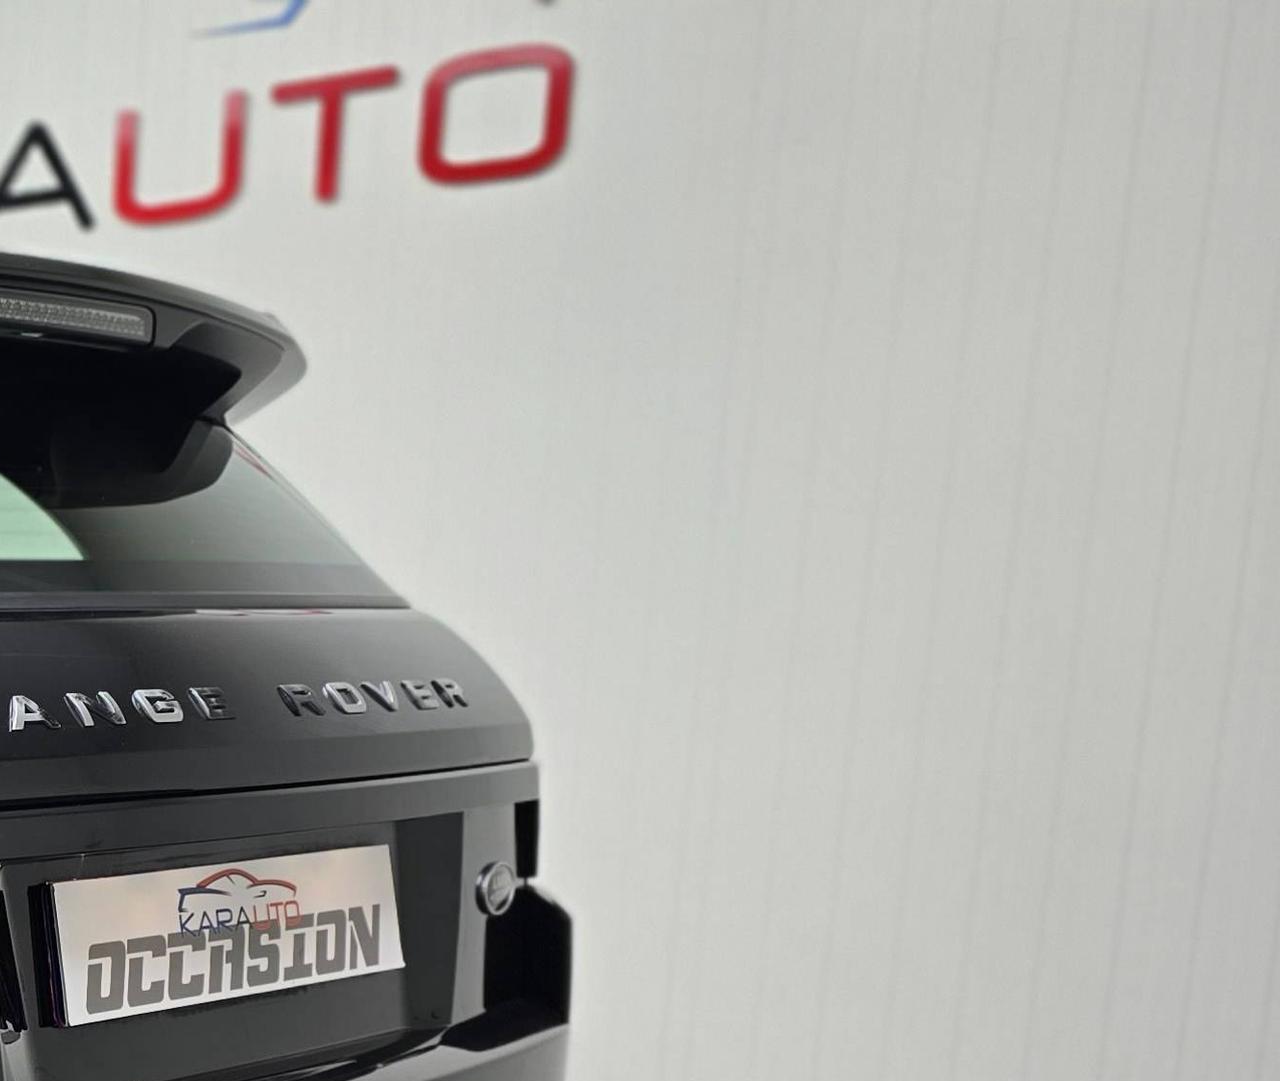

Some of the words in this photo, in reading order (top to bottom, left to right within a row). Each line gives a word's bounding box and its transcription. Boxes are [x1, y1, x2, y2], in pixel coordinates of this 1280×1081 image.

[277, 677, 469, 717] ROVER
[179, 900, 303, 936] KARAUTO
[86, 903, 381, 1015] OCCASION
